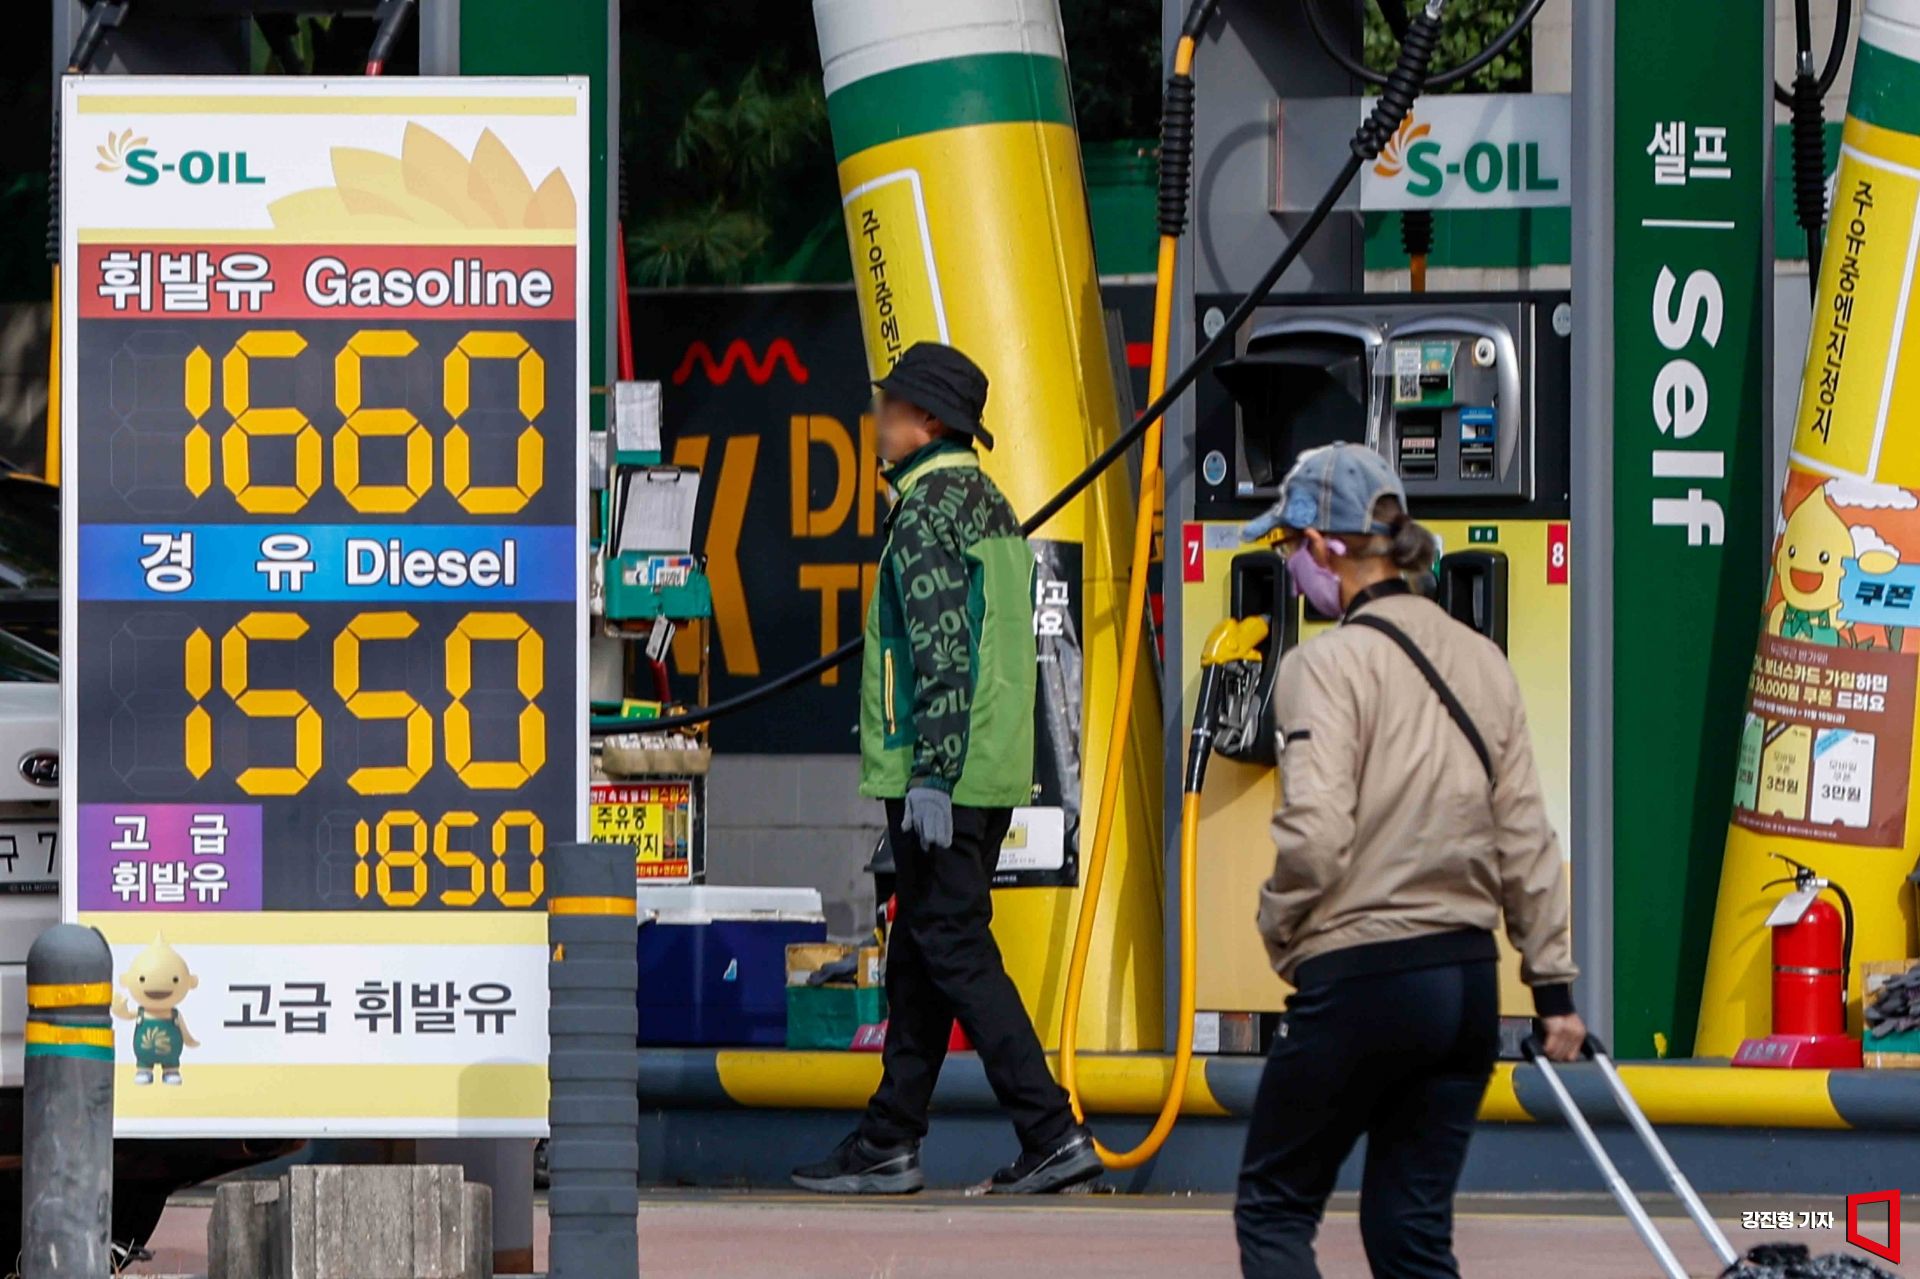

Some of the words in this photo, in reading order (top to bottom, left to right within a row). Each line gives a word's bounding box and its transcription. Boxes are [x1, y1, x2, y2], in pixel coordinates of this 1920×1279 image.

[124, 149, 266, 187] S-OIL
[1406, 141, 1559, 197] S-OIL
[1646, 121, 1732, 186] 셀프
[98, 251, 275, 312] 휘발유
[304, 257, 553, 307] Gasoline
[1811, 180, 1873, 444] 주유중엔진정지
[184, 330, 545, 514] 1660
[1652, 264, 1725, 546] Self
[139, 531, 194, 592] 경
[255, 533, 316, 592] 유
[345, 538, 517, 586] Diesel
[1187, 542, 1199, 566] 7
[1552, 542, 1564, 567] 8
[1855, 580, 1916, 609] 쿠폰
[1803, 688, 1832, 708] 쿠폰
[1836, 691, 1886, 713] 드려요
[1825, 669, 1888, 692] 가입하면
[184, 611, 545, 796] 1550
[1766, 775, 1798, 795] 3천원
[1821, 783, 1861, 803] 3만원
[110, 816, 150, 853] 고
[189, 813, 229, 855] 급
[598, 806, 648, 831] 주유중
[354, 809, 546, 907] 1850
[111, 861, 229, 903] 휘발유
[222, 982, 332, 1034] 고급
[352, 980, 517, 1035] 휘발유
